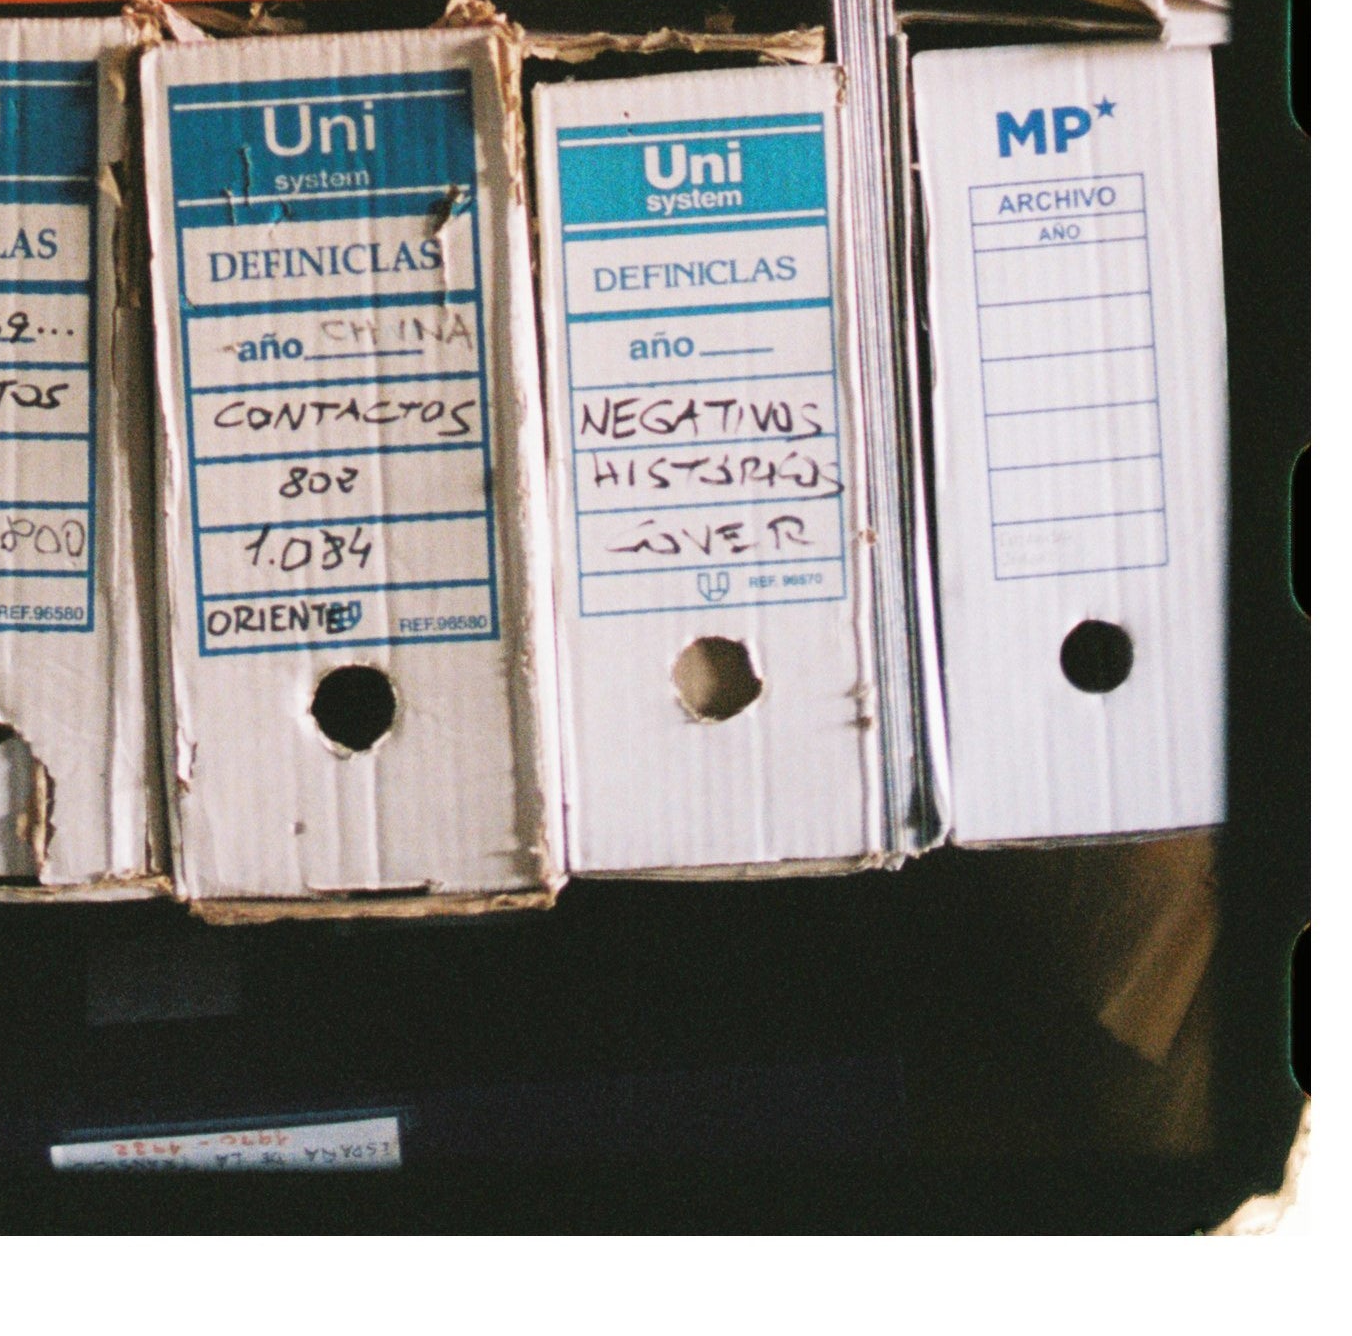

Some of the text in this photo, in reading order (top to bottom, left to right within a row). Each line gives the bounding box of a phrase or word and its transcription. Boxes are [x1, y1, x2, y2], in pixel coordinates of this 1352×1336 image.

[262, 100, 377, 157] Uni
[996, 104, 1093, 159] MP
[274, 168, 371, 192] system
[644, 140, 743, 190] Uni
[646, 188, 743, 216] system
[998, 185, 1117, 215] ARCHIVO
[1039, 222, 1082, 244] AÑO
[209, 241, 443, 283] DEFINICLAS
[594, 255, 798, 293] DEFINICLAS
[237, 333, 304, 364] año
[629, 331, 695, 361] año
[214, 399, 477, 437] CONTACTOS
[580, 396, 824, 441] NEGATIVOS
[279, 466, 358, 499] 802
[207, 603, 350, 637] ORIENTE
